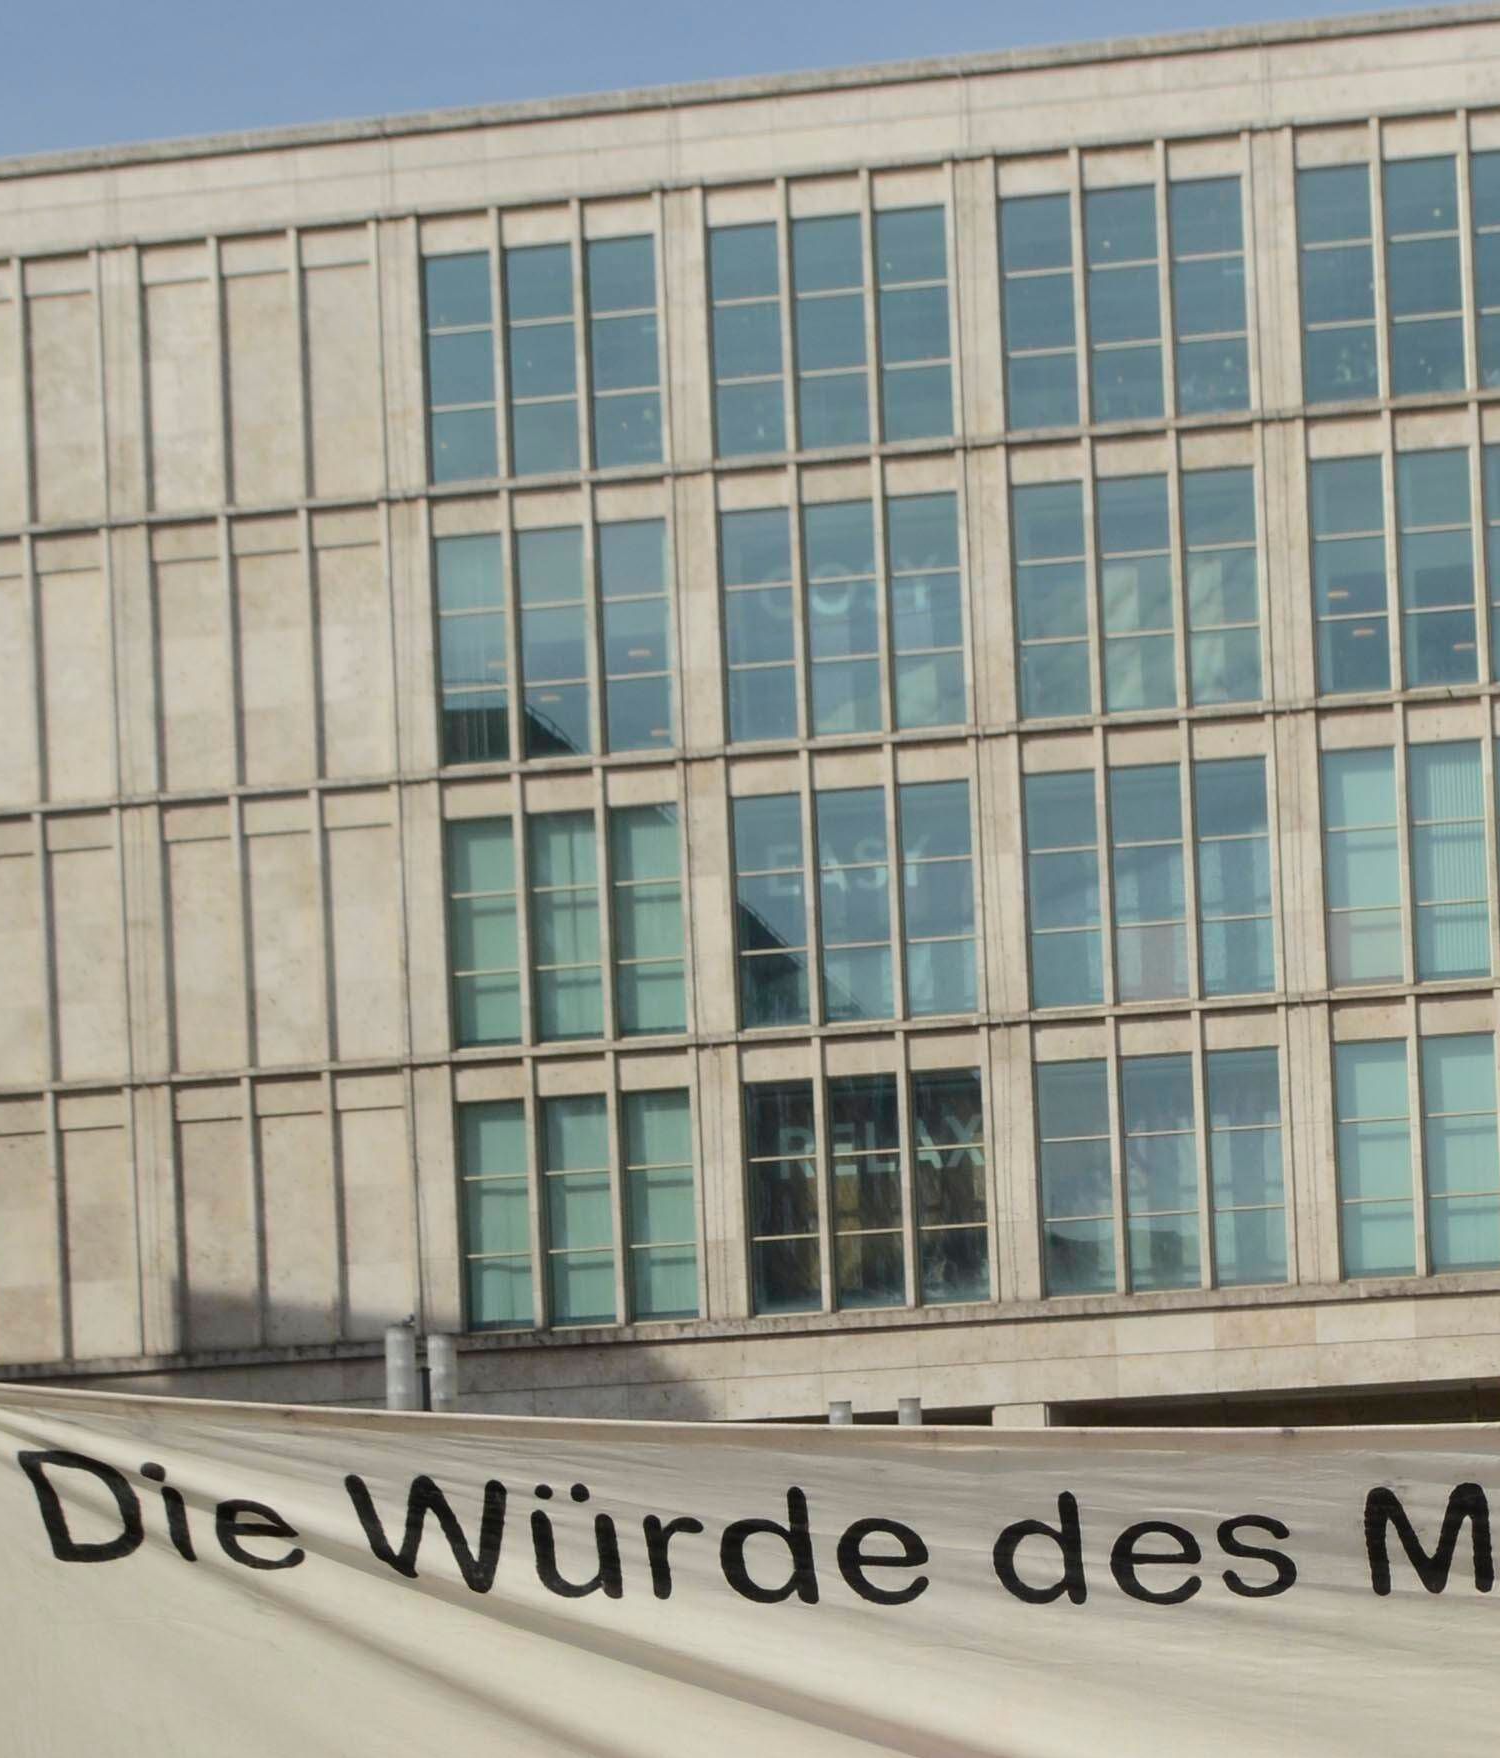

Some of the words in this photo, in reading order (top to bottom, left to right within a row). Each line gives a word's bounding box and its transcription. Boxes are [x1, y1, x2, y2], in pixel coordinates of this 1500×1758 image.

[18, 1449, 305, 1570] Die
[344, 1474, 930, 1605] Würde
[991, 1490, 1298, 1606] des
